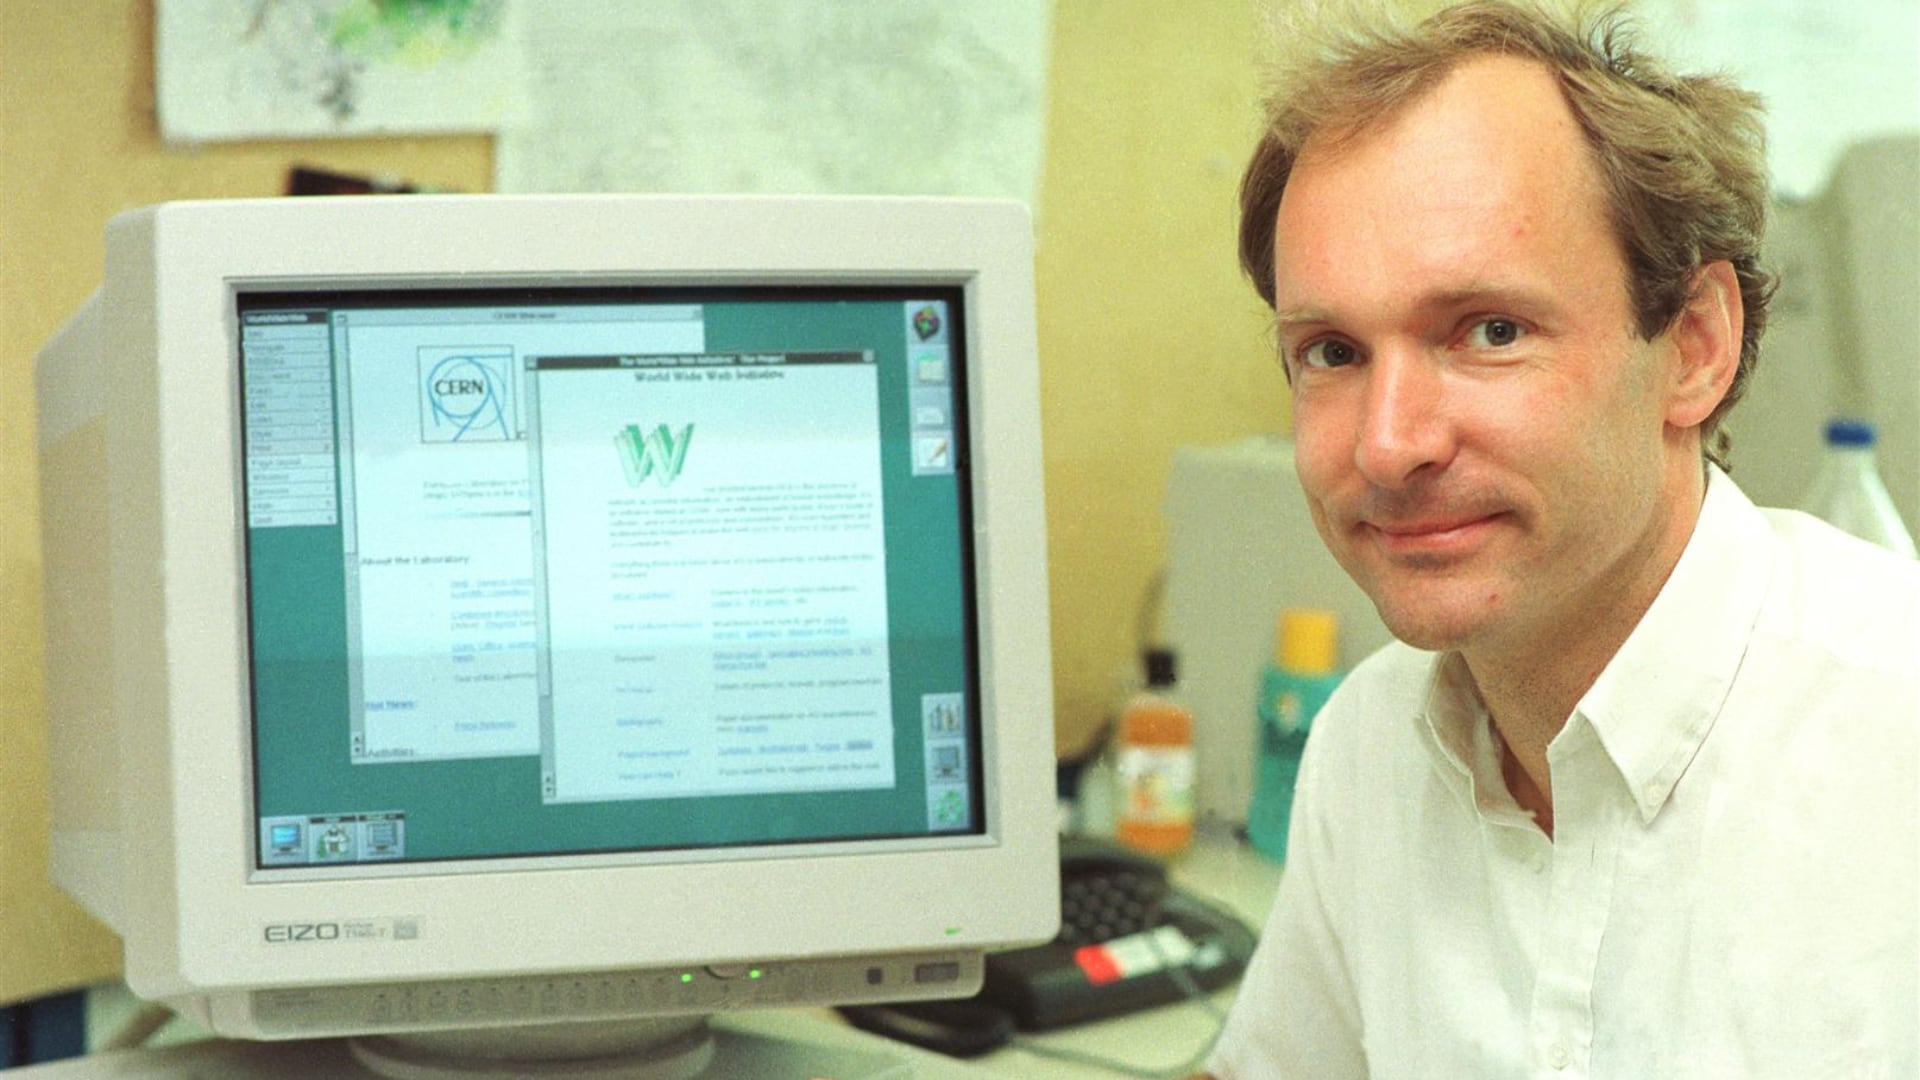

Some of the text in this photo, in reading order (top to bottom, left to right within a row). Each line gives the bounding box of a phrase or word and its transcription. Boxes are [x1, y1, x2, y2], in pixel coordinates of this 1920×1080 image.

[635, 371, 670, 382] World
[674, 371, 703, 382] Wide
[706, 370, 733, 382] Web
[435, 378, 485, 397] CERN
[362, 554, 470, 567] About the Laboratory
[264, 922, 340, 943] EIZO
